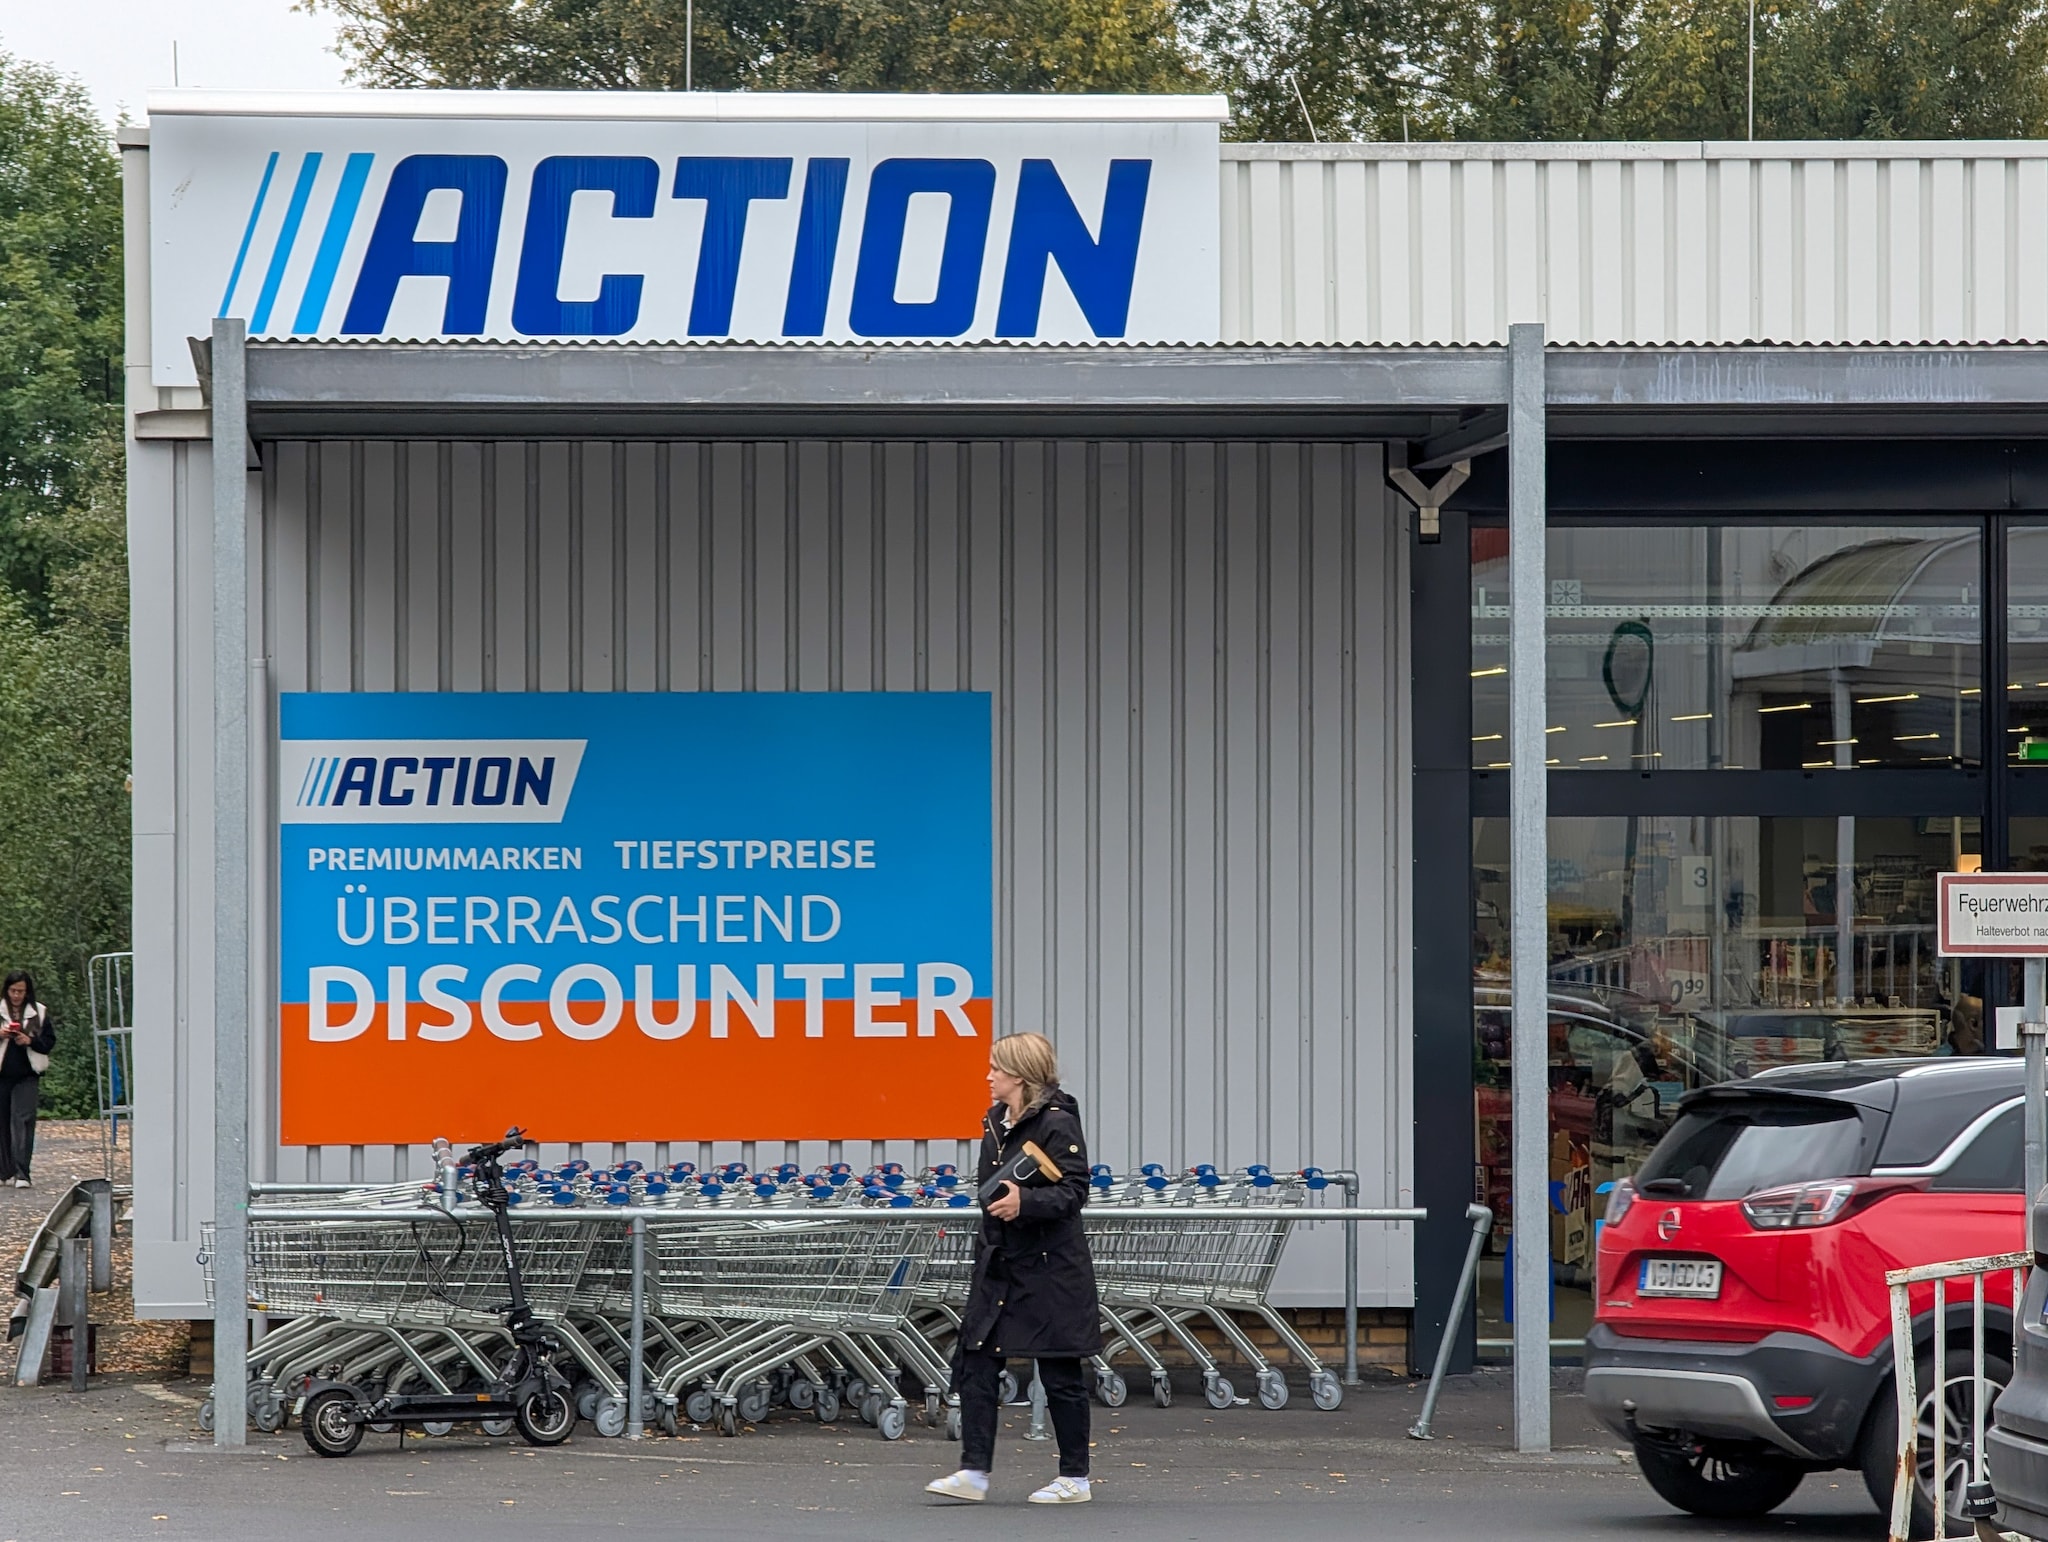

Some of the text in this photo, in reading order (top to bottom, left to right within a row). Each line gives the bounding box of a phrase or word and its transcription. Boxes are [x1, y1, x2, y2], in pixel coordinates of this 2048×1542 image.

[341, 154, 1152, 339] ACTION
[332, 757, 555, 806] ACTION
[308, 847, 582, 871] PREMIUMMARKEN
[614, 840, 876, 869] TIEFSTPREISE
[1694, 866, 1708, 888] 3
[337, 884, 841, 945] ÜBERRASCHEND
[1976, 925, 2029, 937] Halteverbot
[308, 962, 978, 1042] DISCOUNTER
